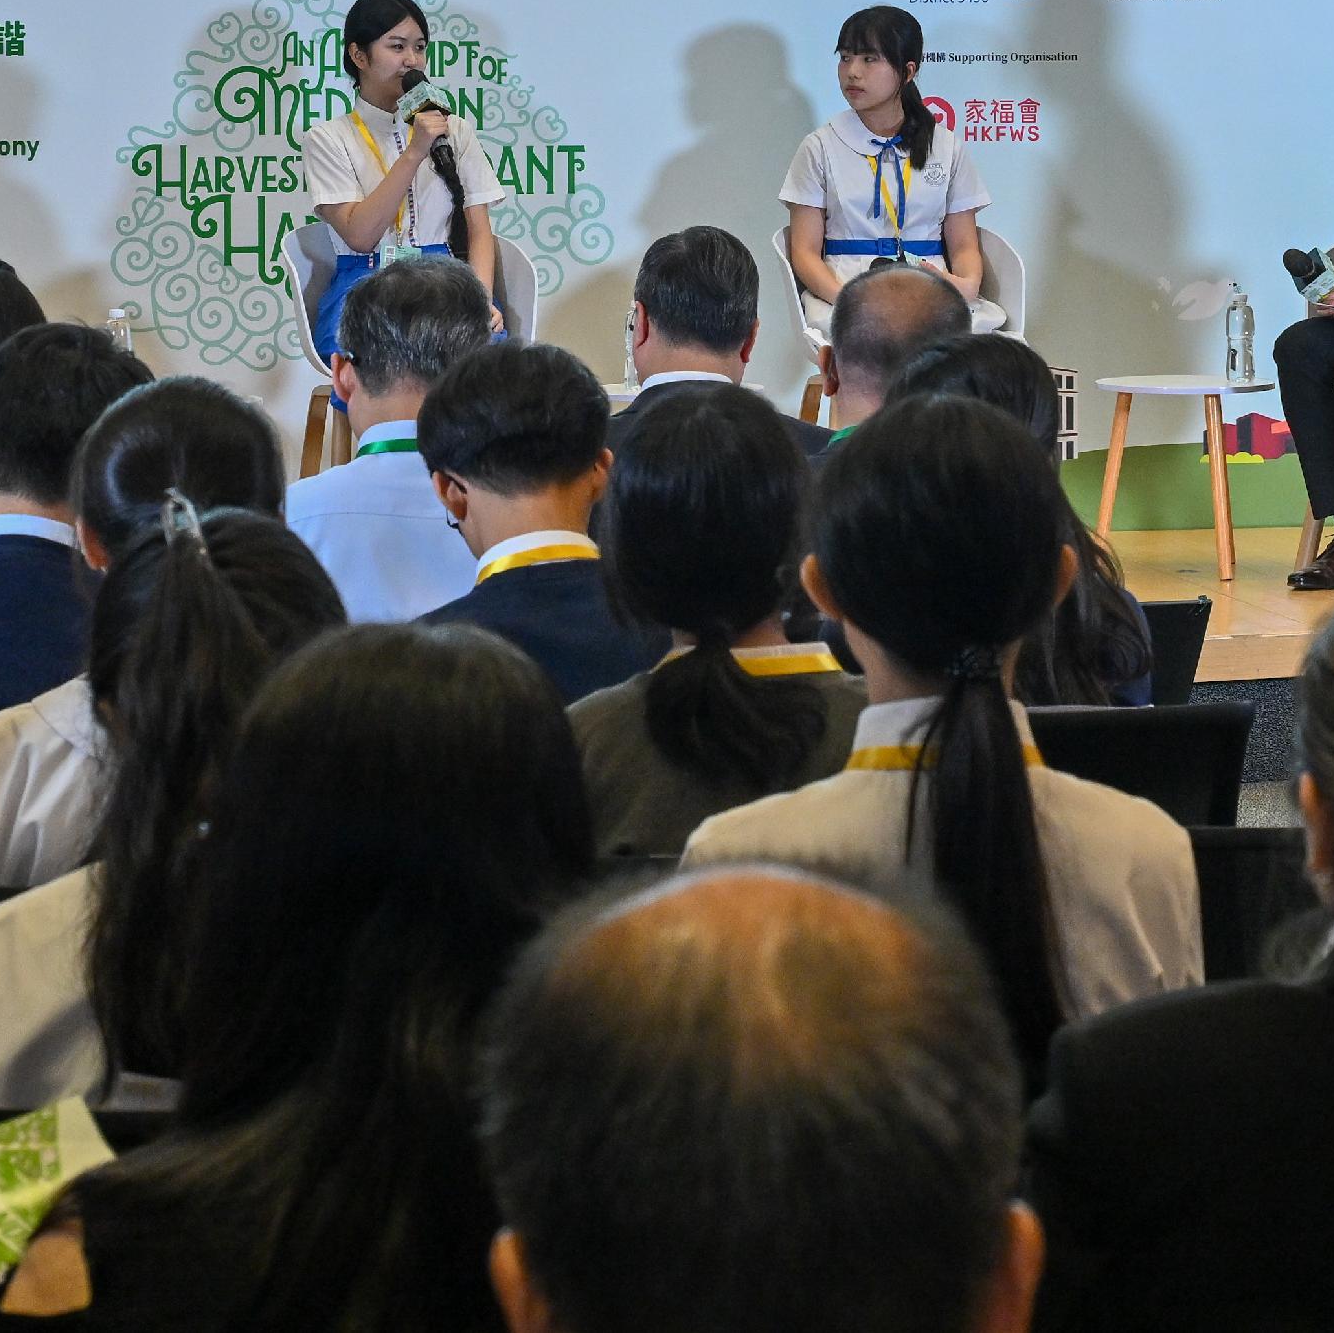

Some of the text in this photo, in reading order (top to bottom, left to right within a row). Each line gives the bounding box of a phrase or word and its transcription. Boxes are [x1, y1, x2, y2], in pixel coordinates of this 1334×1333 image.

[948, 52, 1078, 64] Supporting Organisation
[479, 55, 508, 84] OF
[964, 98, 1041, 124] 家福會
[964, 126, 1041, 141] HKFWS
